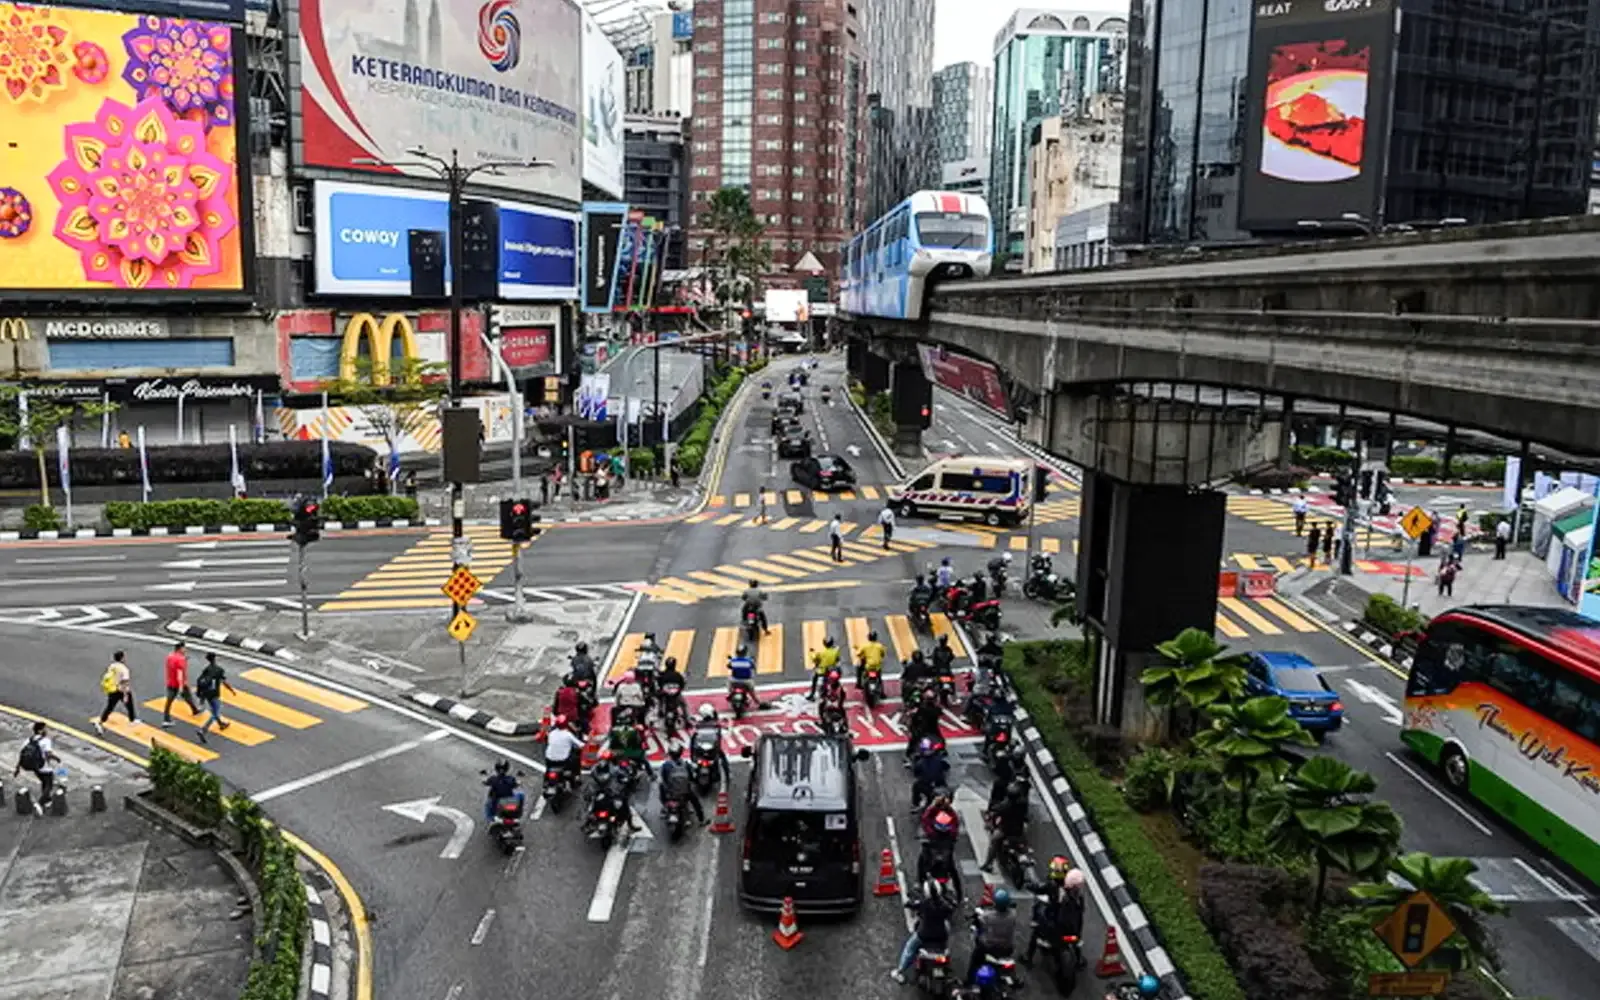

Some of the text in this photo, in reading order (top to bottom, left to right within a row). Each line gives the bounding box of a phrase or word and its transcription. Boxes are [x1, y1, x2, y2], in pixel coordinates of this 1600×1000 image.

[352, 54, 495, 102] KETERANGKUMAN
[499, 86, 521, 108] DAN
[341, 228, 399, 248] coway
[46, 322, 160, 337] McDonald's
